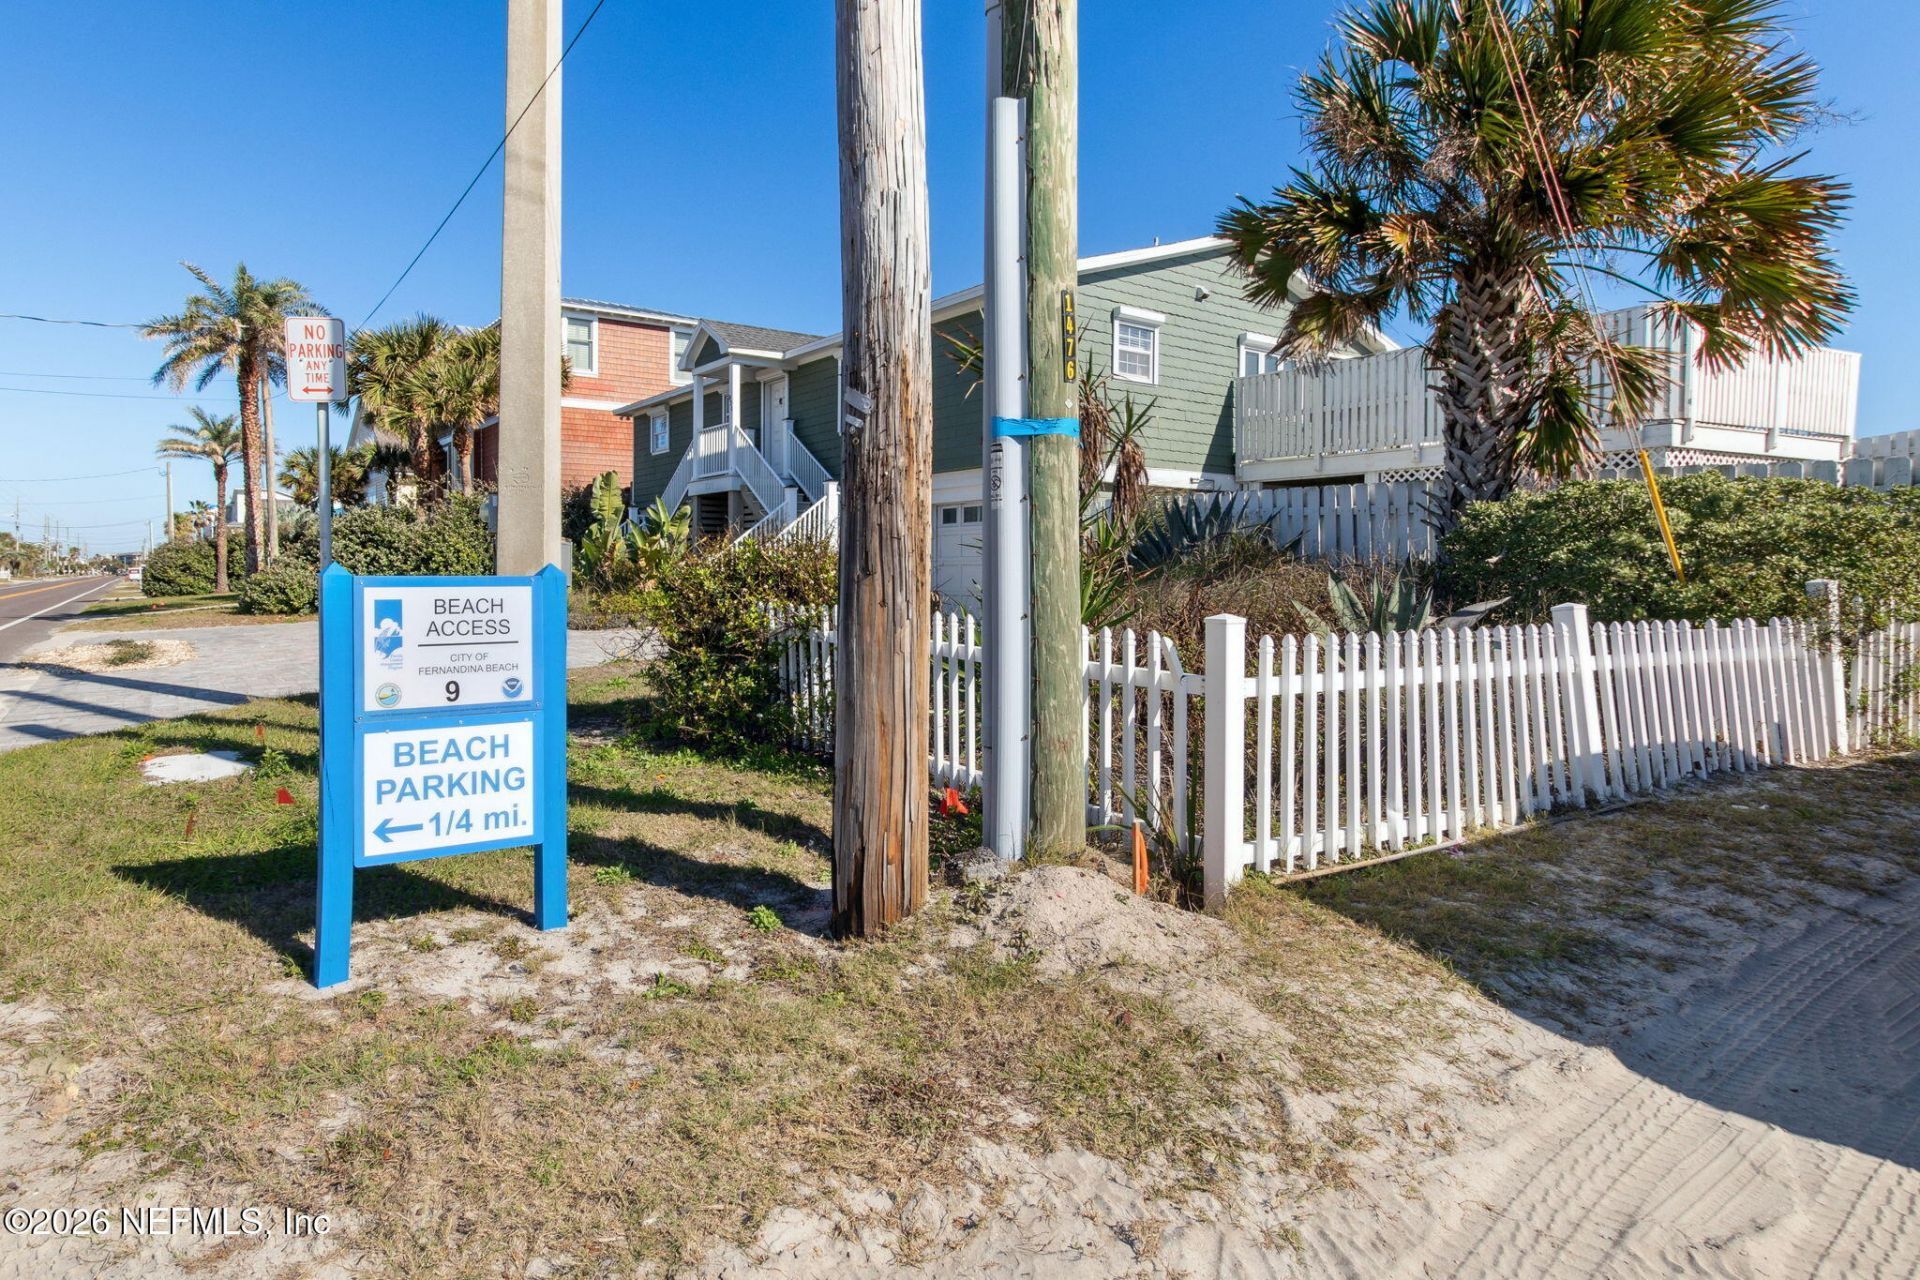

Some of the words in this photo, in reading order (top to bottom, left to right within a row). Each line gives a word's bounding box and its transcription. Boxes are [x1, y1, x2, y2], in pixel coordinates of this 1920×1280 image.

[304, 324, 326, 340] NO
[1065, 294, 1075, 380] 1476
[289, 343, 343, 359] PARKING
[306, 361, 327, 371] ANY
[304, 373, 330, 383] TIME
[434, 598, 504, 615] BEACH
[426, 619, 511, 637] ACCESS
[450, 653, 473, 663] CITY
[475, 652, 489, 662] OF
[418, 665, 484, 676] FERNANDINA
[485, 663, 519, 673] BEACH
[445, 680, 460, 702] 9
[393, 734, 510, 768] BEACH
[376, 766, 526, 806] PARKING
[428, 808, 473, 837] 1/4
[484, 803, 527, 831] mi.
